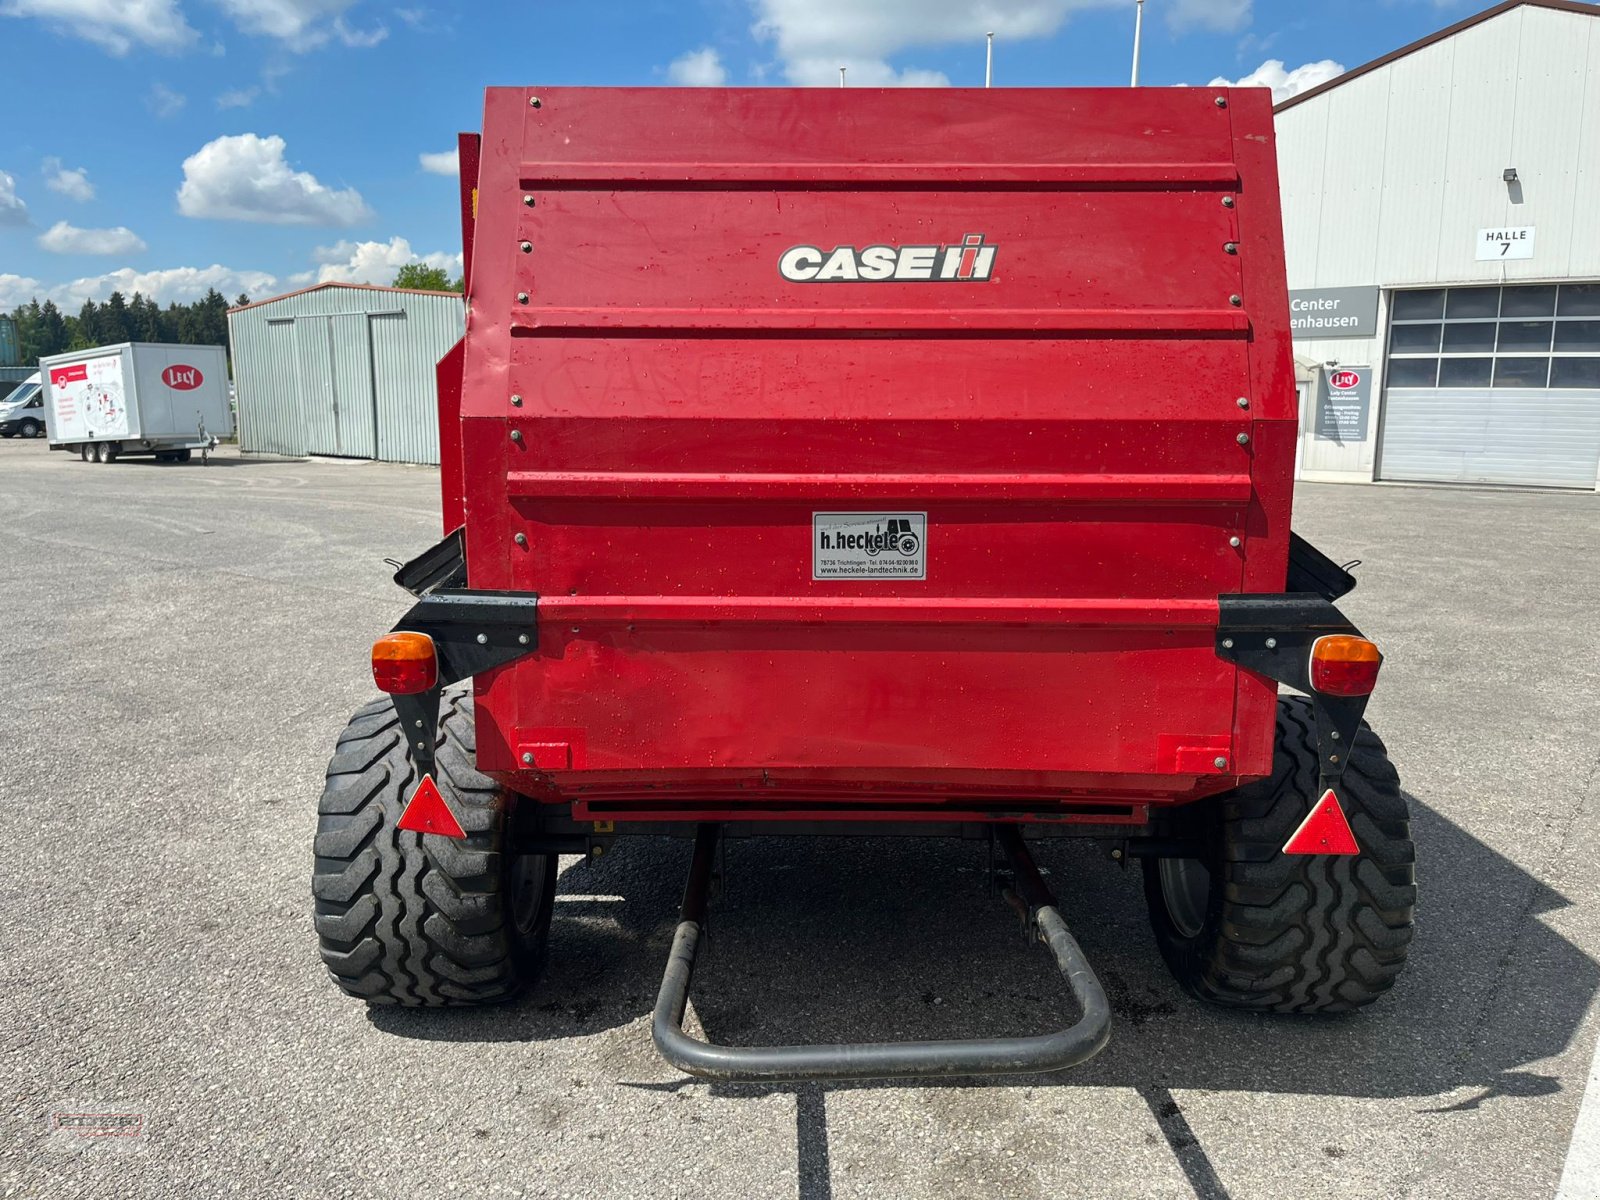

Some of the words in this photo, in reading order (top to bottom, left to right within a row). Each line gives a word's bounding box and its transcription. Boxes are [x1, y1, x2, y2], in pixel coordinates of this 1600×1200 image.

[1486, 230, 1527, 241] HALLE
[1500, 242, 1511, 256] 7
[780, 246, 937, 281] CASE
[1291, 298, 1341, 311] Center
[169, 368, 195, 386] LELY
[820, 531, 898, 550] h.heckele
[837, 559, 867, 567] Trichtingen
[820, 566, 919, 574] www.heckele-landtechnik.de
